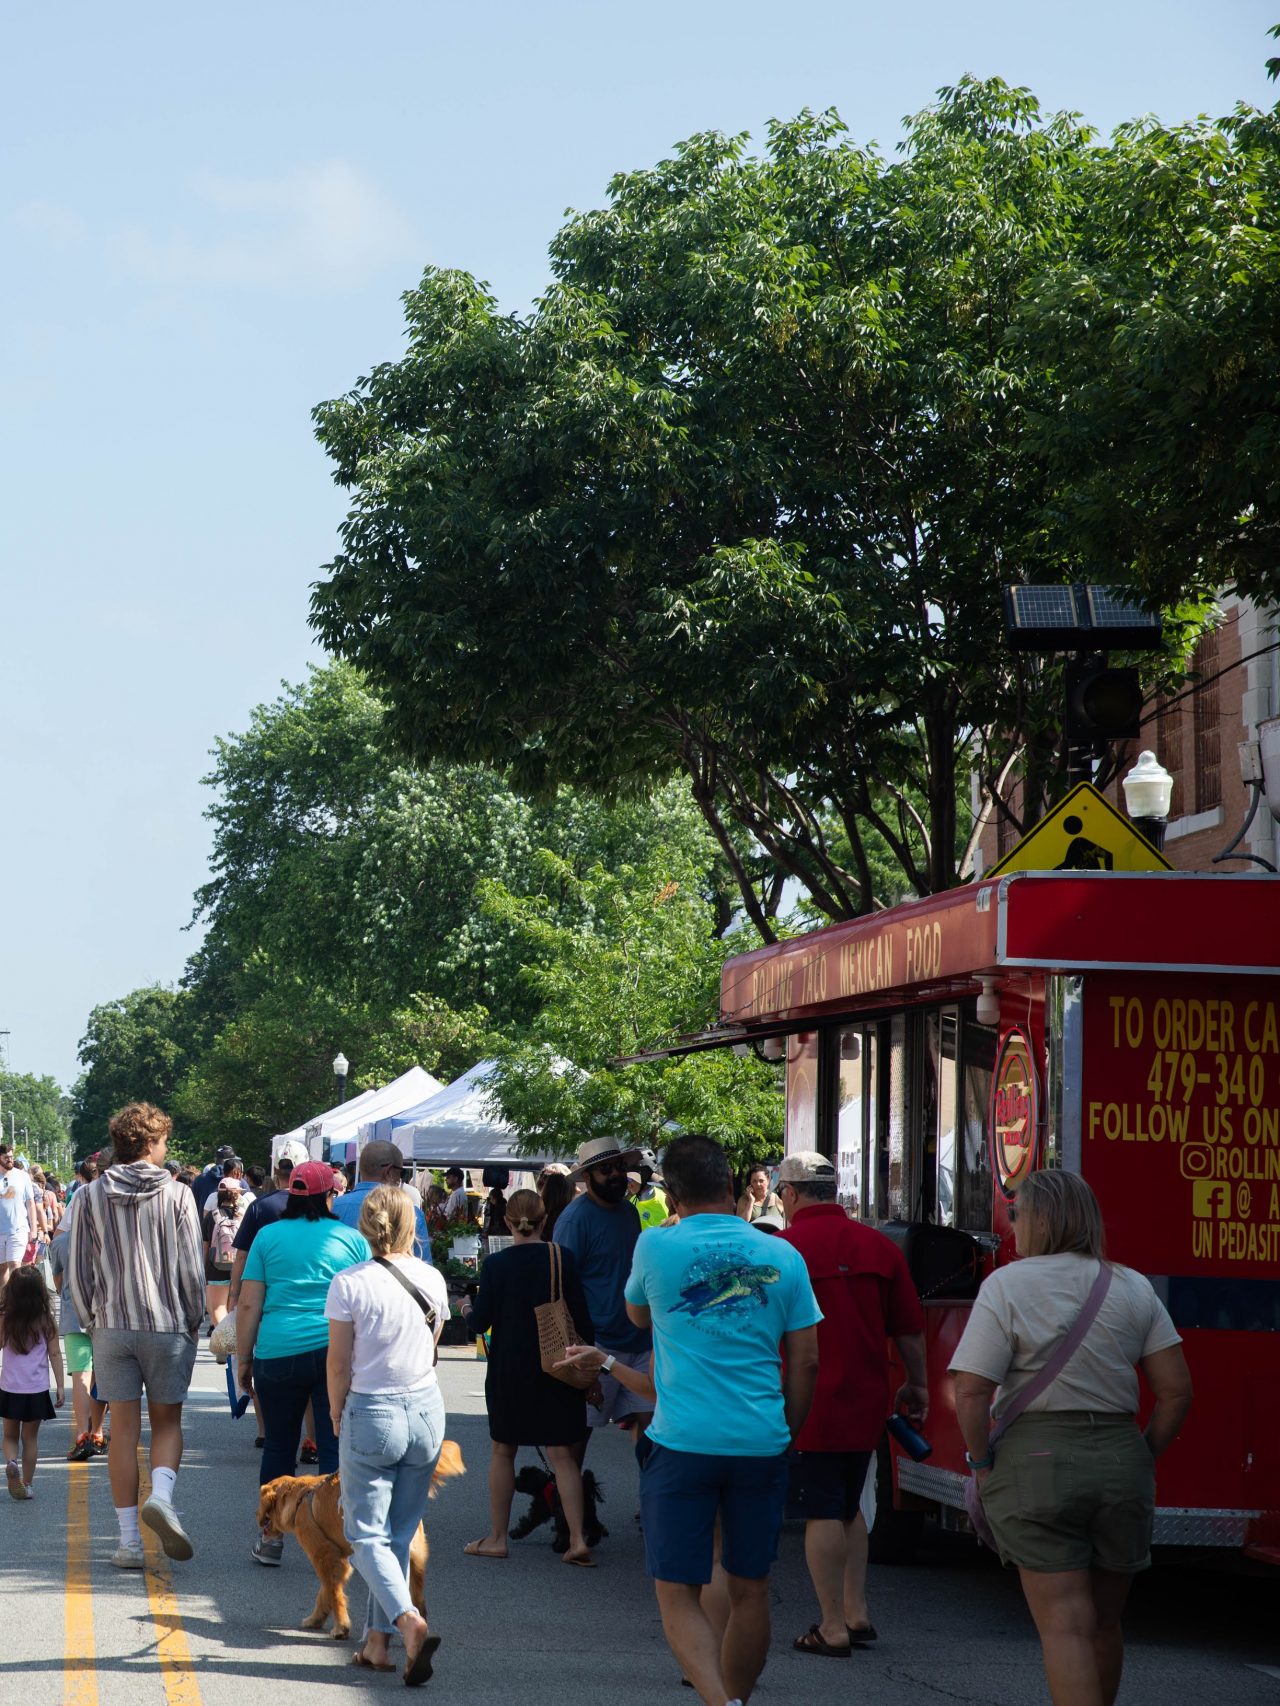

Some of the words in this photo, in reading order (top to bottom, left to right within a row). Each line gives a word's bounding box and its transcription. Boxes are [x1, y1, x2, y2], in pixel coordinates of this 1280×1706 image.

[752, 961, 794, 1016] ROLLING
[801, 952, 827, 1005] TACO
[839, 934, 893, 996] MEXICAN
[906, 921, 942, 983] FOOD
[1109, 996, 1144, 1048] TO
[1153, 998, 1235, 1052] ORDER
[1244, 1001, 1280, 1054] CA
[1089, 1102, 1191, 1142] FOLLOW
[1203, 1106, 1233, 1144] US
[1243, 1107, 1279, 1146] ON
[692, 1242, 756, 1257] BELIZE
[1192, 1220, 1213, 1258] UN
